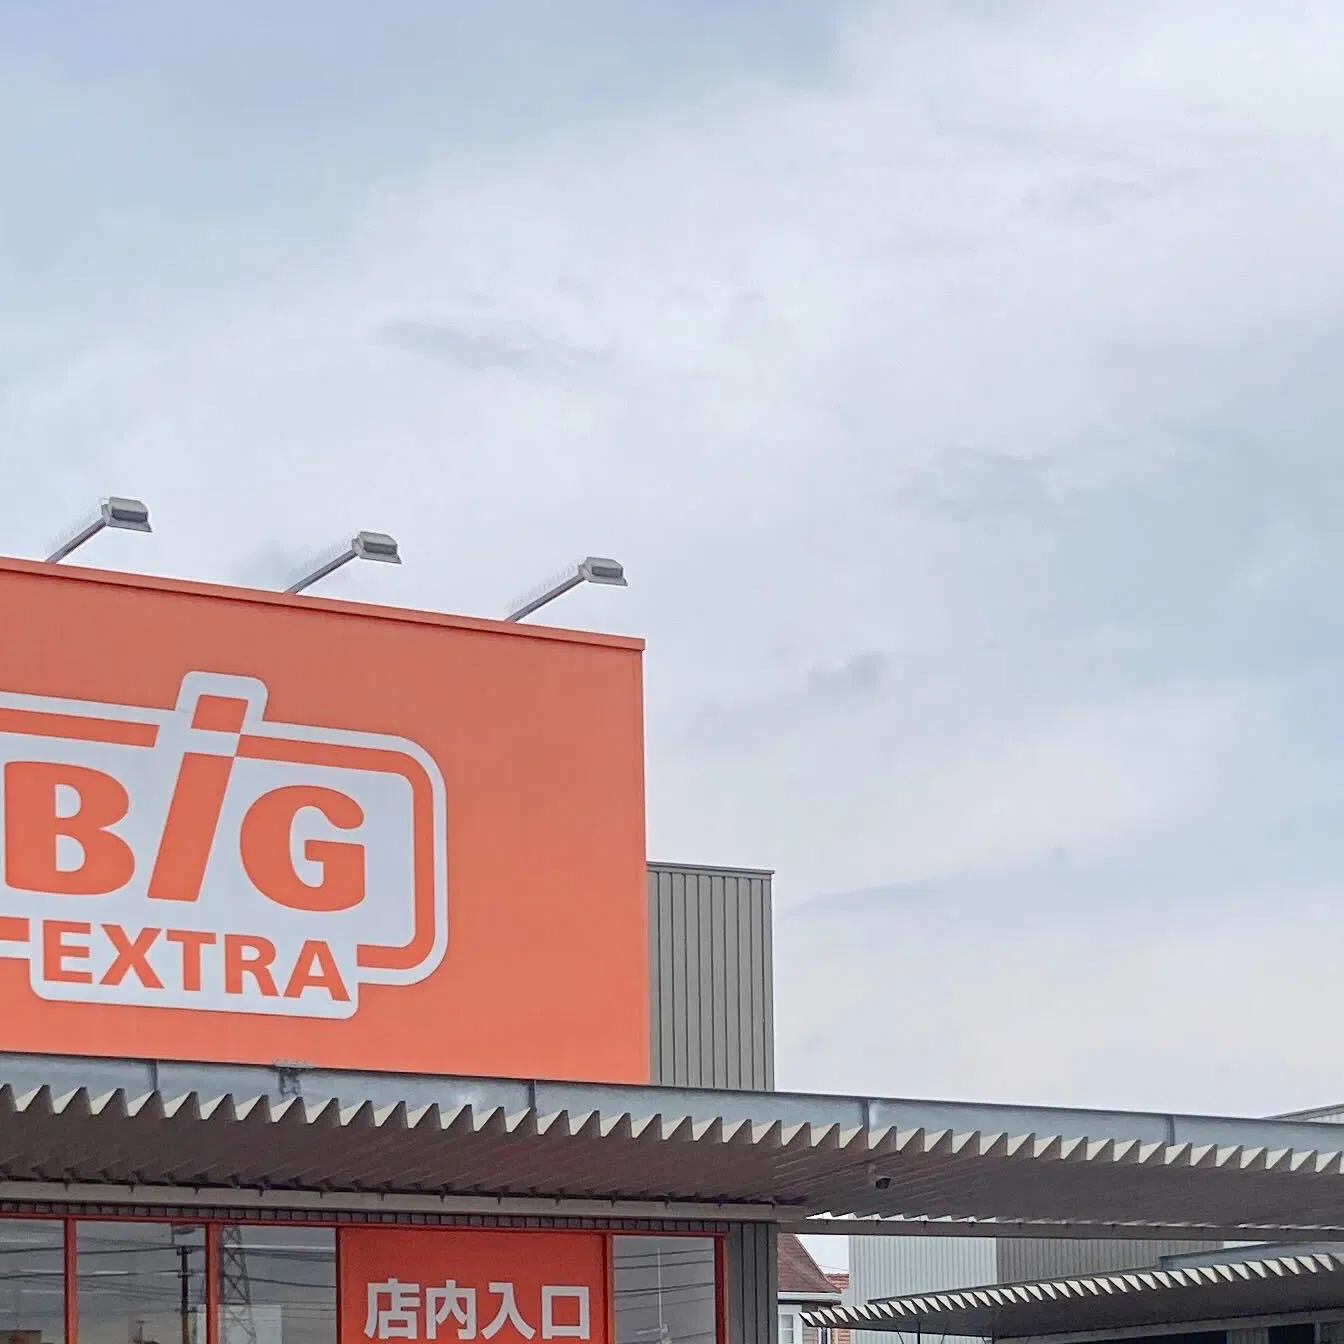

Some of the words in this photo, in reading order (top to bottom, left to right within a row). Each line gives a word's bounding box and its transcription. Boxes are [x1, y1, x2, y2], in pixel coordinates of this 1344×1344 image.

[41, 919, 352, 1002] EXTRA
[363, 1277, 591, 1341] 店内入口
